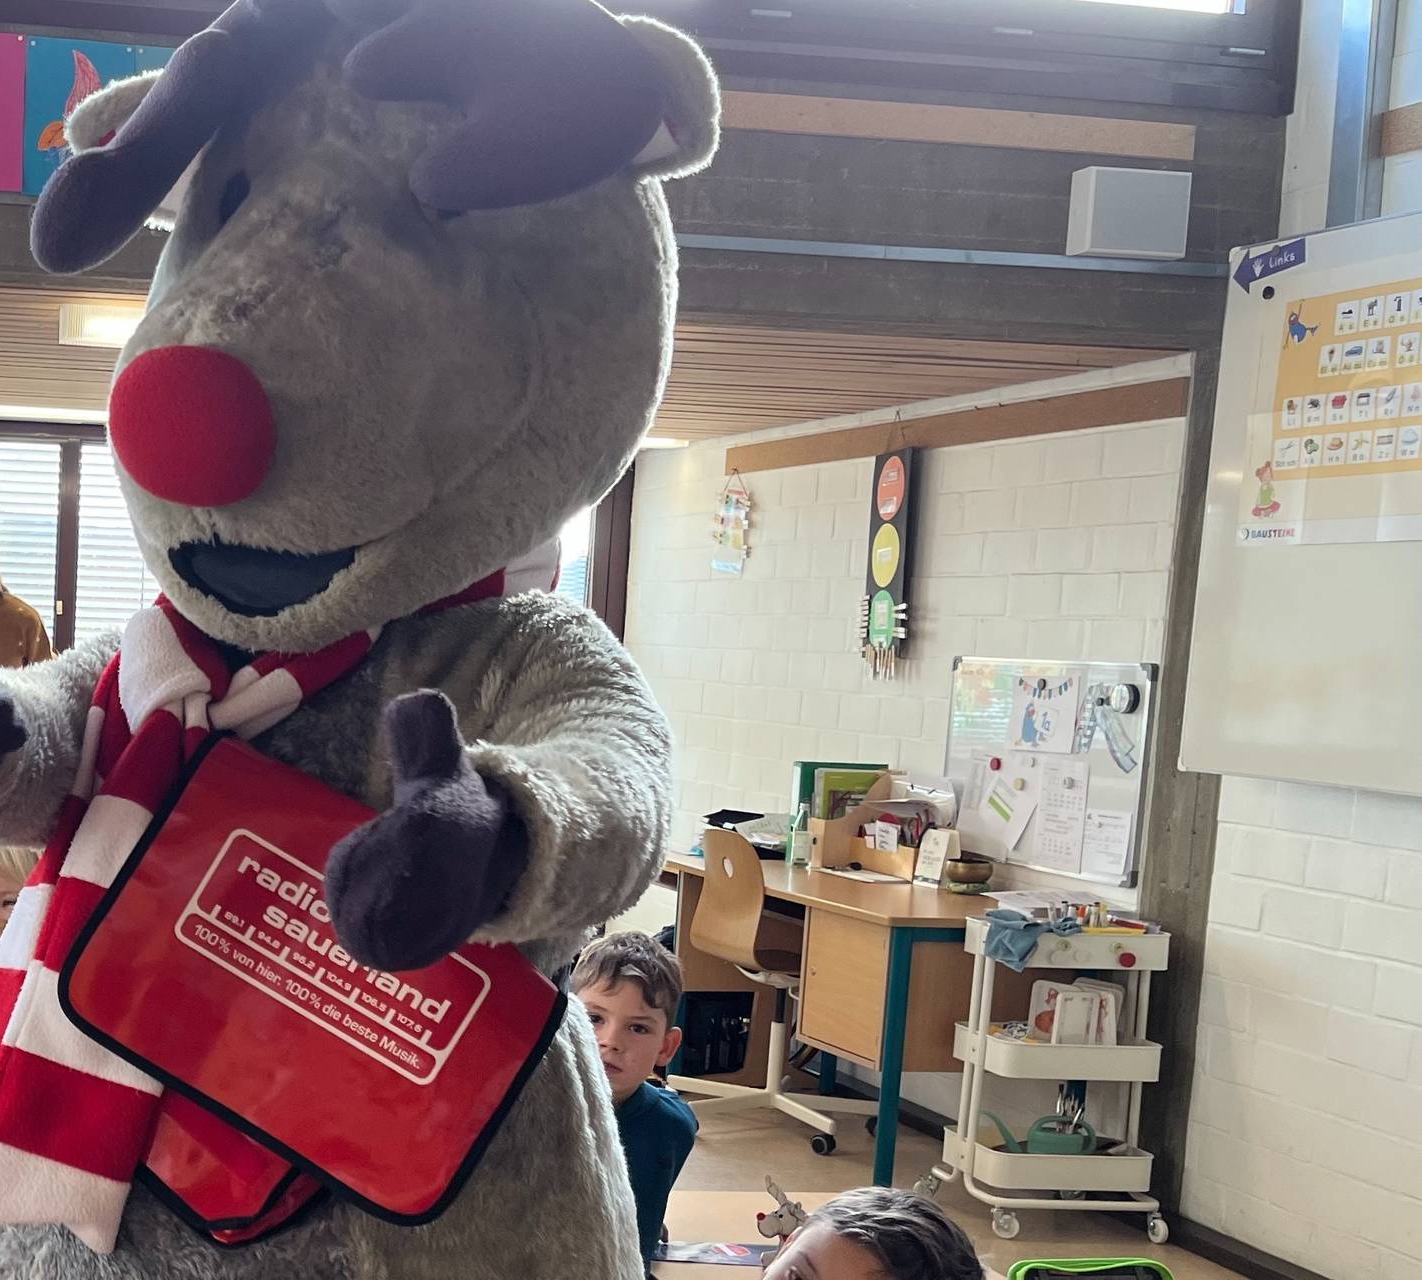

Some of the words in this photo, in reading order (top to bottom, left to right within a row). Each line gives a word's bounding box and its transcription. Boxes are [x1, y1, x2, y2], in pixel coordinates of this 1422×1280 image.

[1269, 251, 1296, 268] Links
[1251, 528, 1296, 538] BAUSTEINE
[238, 856, 331, 923] radio
[194, 924, 230, 954] 100%
[232, 949, 255, 969] von
[255, 960, 282, 986] hier.
[285, 979, 321, 1009] 100%
[321, 1003, 342, 1021] die
[342, 1014, 379, 1043] beste
[379, 1035, 421, 1070] Musik.
[292, 952, 316, 970] 96.2
[326, 971, 352, 991] 104.9
[397, 1014, 423, 1033] 107.6
